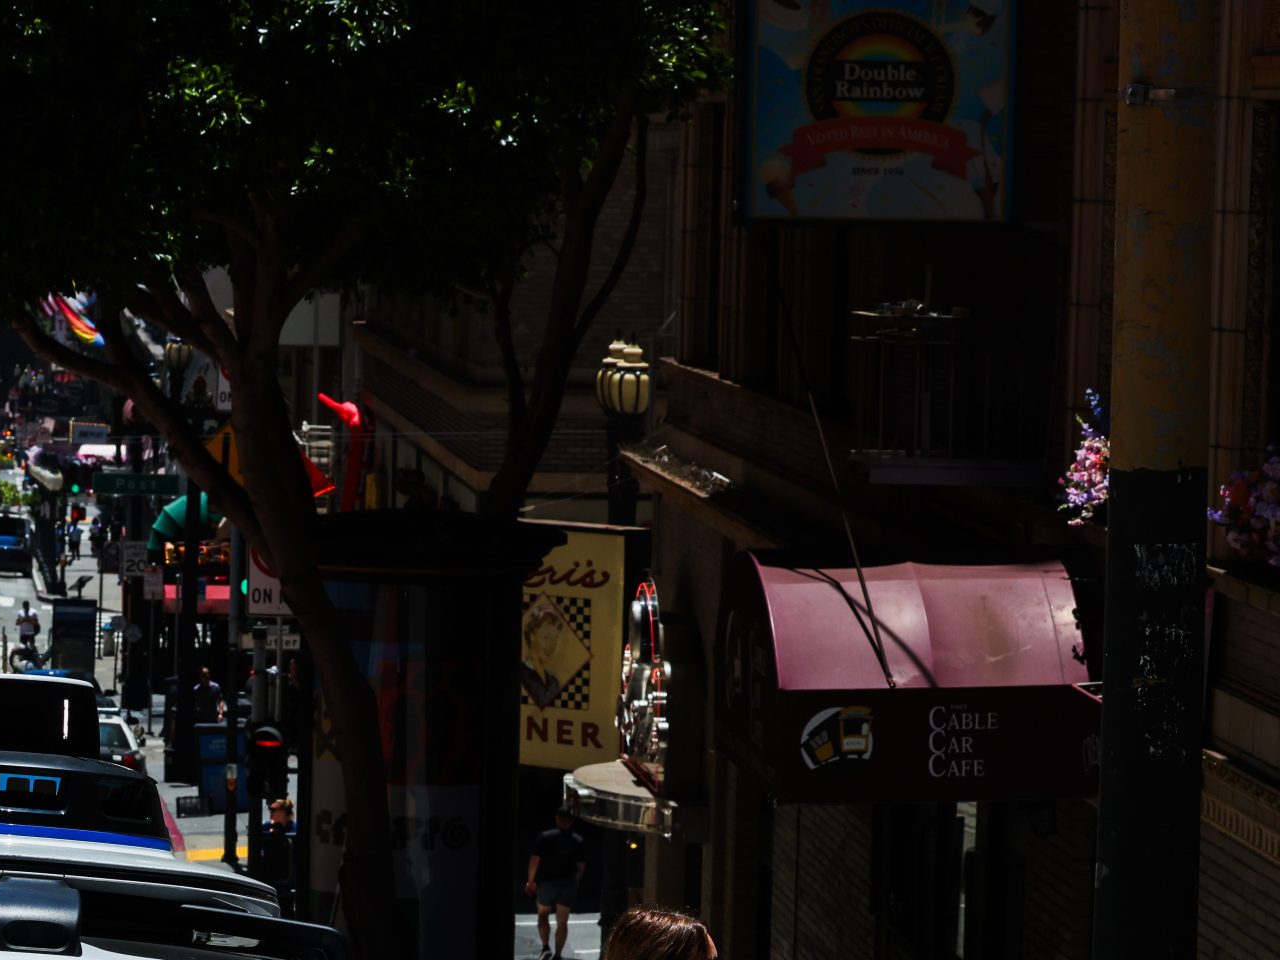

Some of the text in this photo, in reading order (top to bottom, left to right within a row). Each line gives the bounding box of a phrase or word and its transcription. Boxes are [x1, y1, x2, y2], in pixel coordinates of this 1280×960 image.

[843, 63, 917, 81] Double
[835, 81, 924, 99] Rainbow
[804, 125, 950, 149] VOTED BEST IN AMERICA
[851, 167, 880, 175] SINCE
[116, 478, 157, 490] Post
[126, 559, 146, 572] 20
[252, 588, 272, 603] ON
[929, 706, 999, 731] CABLE
[526, 716, 603, 749] NER
[929, 730, 974, 754] CAR
[929, 753, 985, 778] CAFE
